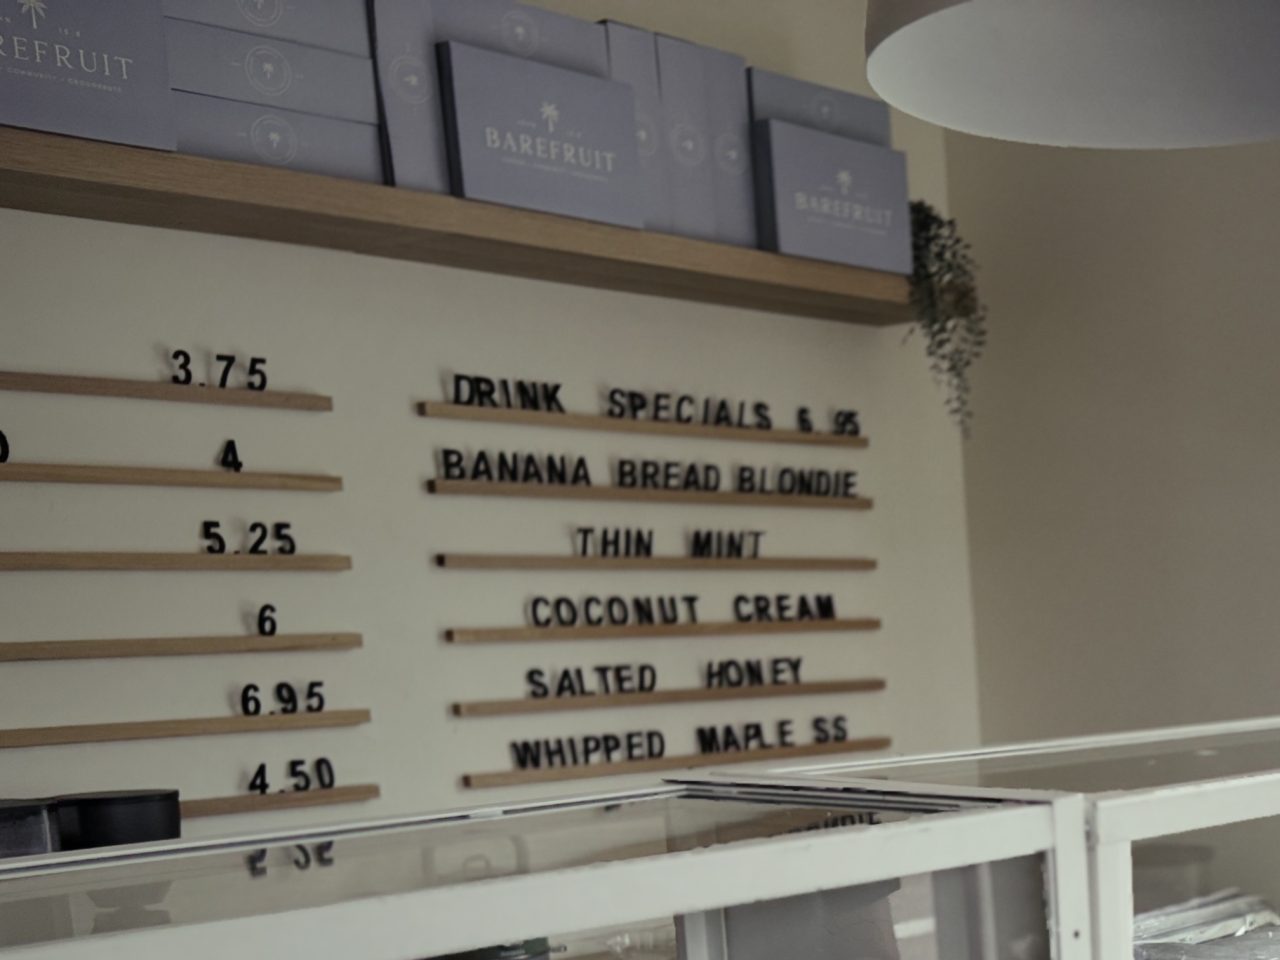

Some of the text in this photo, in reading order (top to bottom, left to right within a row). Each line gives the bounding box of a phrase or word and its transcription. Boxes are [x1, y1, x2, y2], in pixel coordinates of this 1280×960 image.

[485, 126, 616, 173] BAREFRUIT
[171, 350, 268, 392] 3.75
[453, 374, 565, 413] DRINK
[607, 388, 772, 431] SPECIALS
[220, 439, 243, 472] 4
[442, 448, 858, 498] BANANA BREAD BLONDIE
[201, 520, 297, 555] 5.25
[576, 528, 766, 560] THIN MINT
[257, 604, 278, 637] 6
[531, 594, 836, 628] COCONUT CREAM
[526, 657, 803, 700] SALTED HONEY
[240, 681, 326, 717] 6.95
[511, 716, 848, 770] WHIPPED MAPLE SS
[248, 757, 336, 796] 4.50
